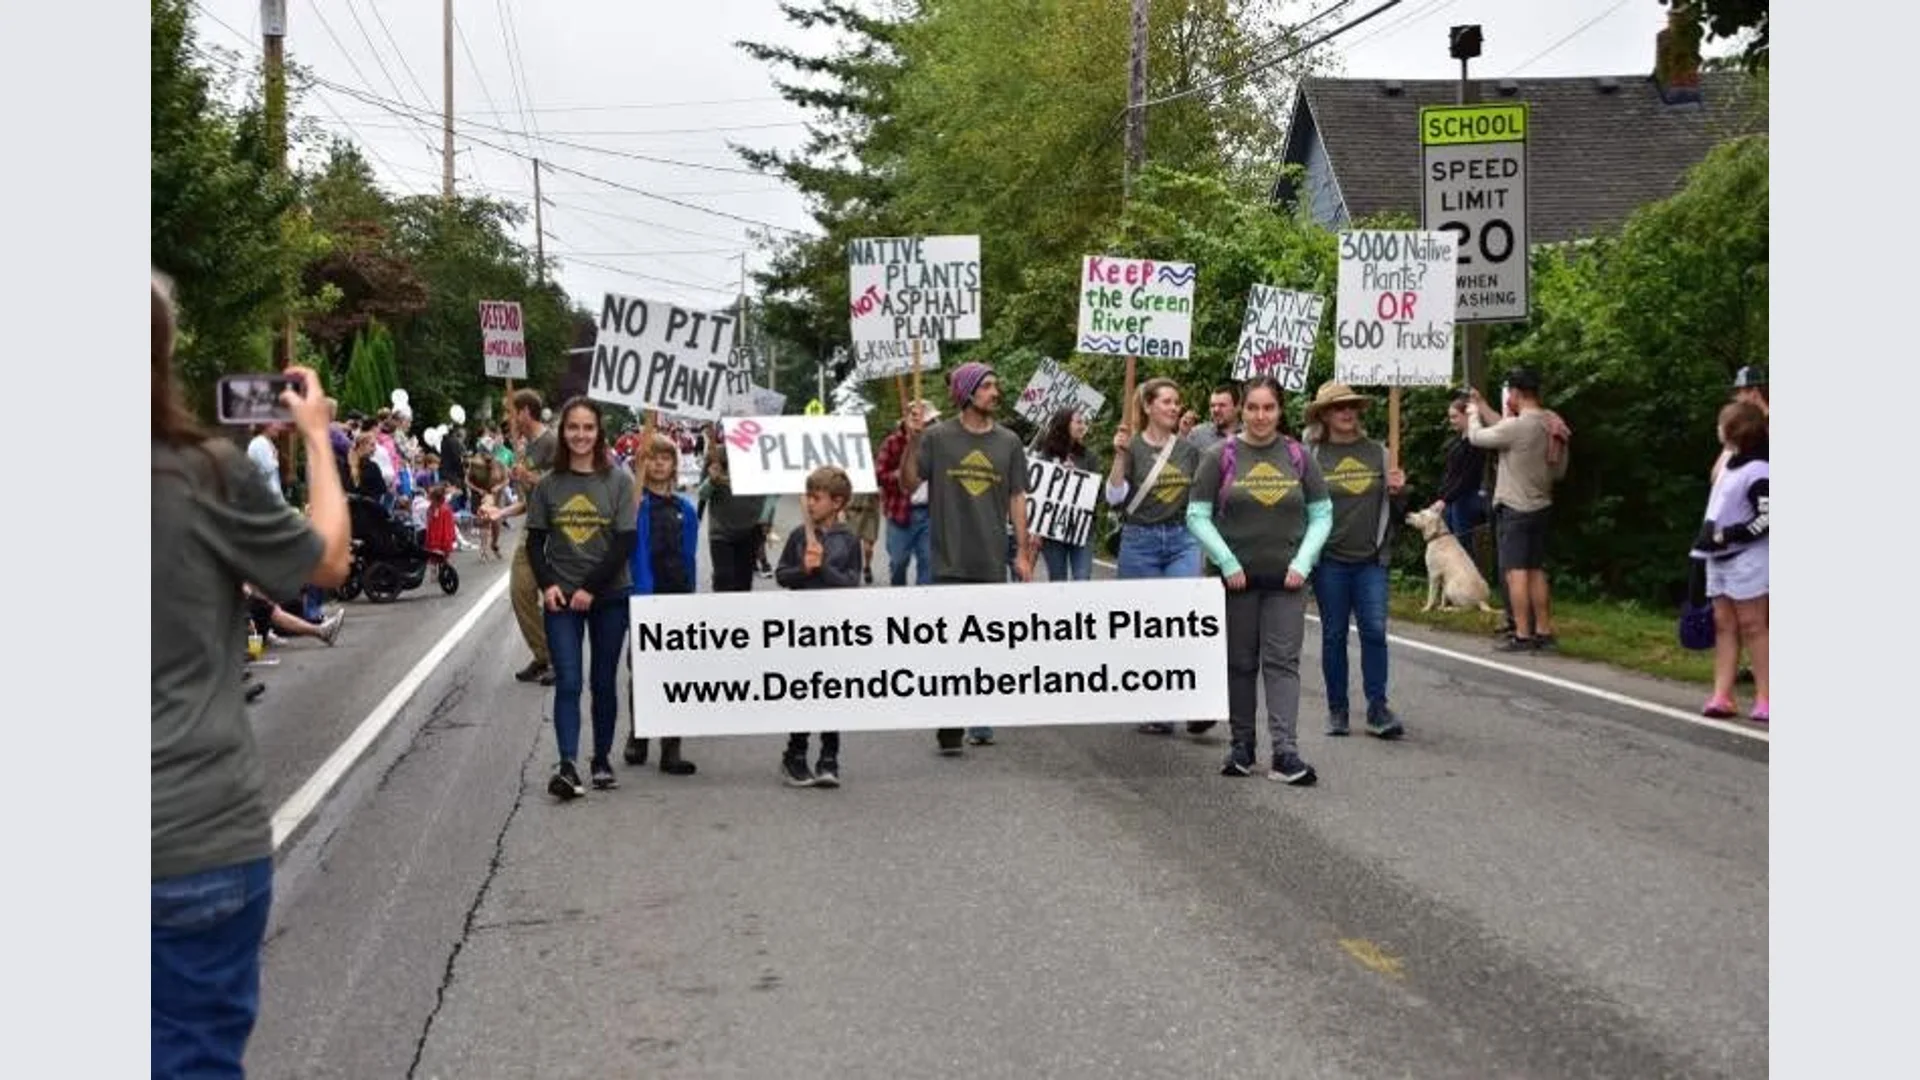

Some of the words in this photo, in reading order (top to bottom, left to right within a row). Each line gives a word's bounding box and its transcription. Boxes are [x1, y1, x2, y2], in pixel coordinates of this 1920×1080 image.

[1429, 115, 1520, 138] SCHOOL
[1431, 158, 1518, 181] SPEED
[1441, 188, 1509, 211] LIMIT
[850, 238, 925, 265] NATIVE
[1341, 232, 1399, 262] 3000
[1404, 232, 1451, 262] Native
[1438, 218, 1515, 265] 20
[886, 261, 978, 291] PLANTS
[1362, 262, 1427, 291] Plants?
[1456, 274, 1498, 289] WHEN
[850, 285, 881, 319] NOT
[881, 287, 980, 317] ASPHALT
[1086, 286, 1122, 309] the
[1130, 285, 1190, 313] Green
[1249, 285, 1323, 321] NATIVE
[1377, 291, 1417, 320] OR
[1457, 291, 1517, 308] ASHING
[600, 293, 648, 337] NO
[665, 306, 732, 354] PIT
[894, 315, 960, 341] PLANT
[1091, 308, 1152, 333] River
[1243, 308, 1317, 346] PLANTS
[1338, 319, 1384, 350] 600
[1125, 334, 1183, 357] Clean
[592, 343, 642, 396] NO
[644, 350, 728, 411] PLANT
[1233, 356, 1304, 390] PLNTS
[724, 419, 761, 453] NO
[757, 431, 869, 471] PLANT
[1024, 462, 1044, 494] O
[1046, 465, 1091, 505] PIT
[1036, 501, 1094, 544] PLANT
[639, 620, 750, 652] Native
[763, 616, 873, 649] Plants
[886, 616, 948, 645] Not
[958, 611, 1097, 651] Asphalt
[1109, 610, 1220, 640] Plants
[662, 665, 1197, 704] www.DefendCumberland.com
